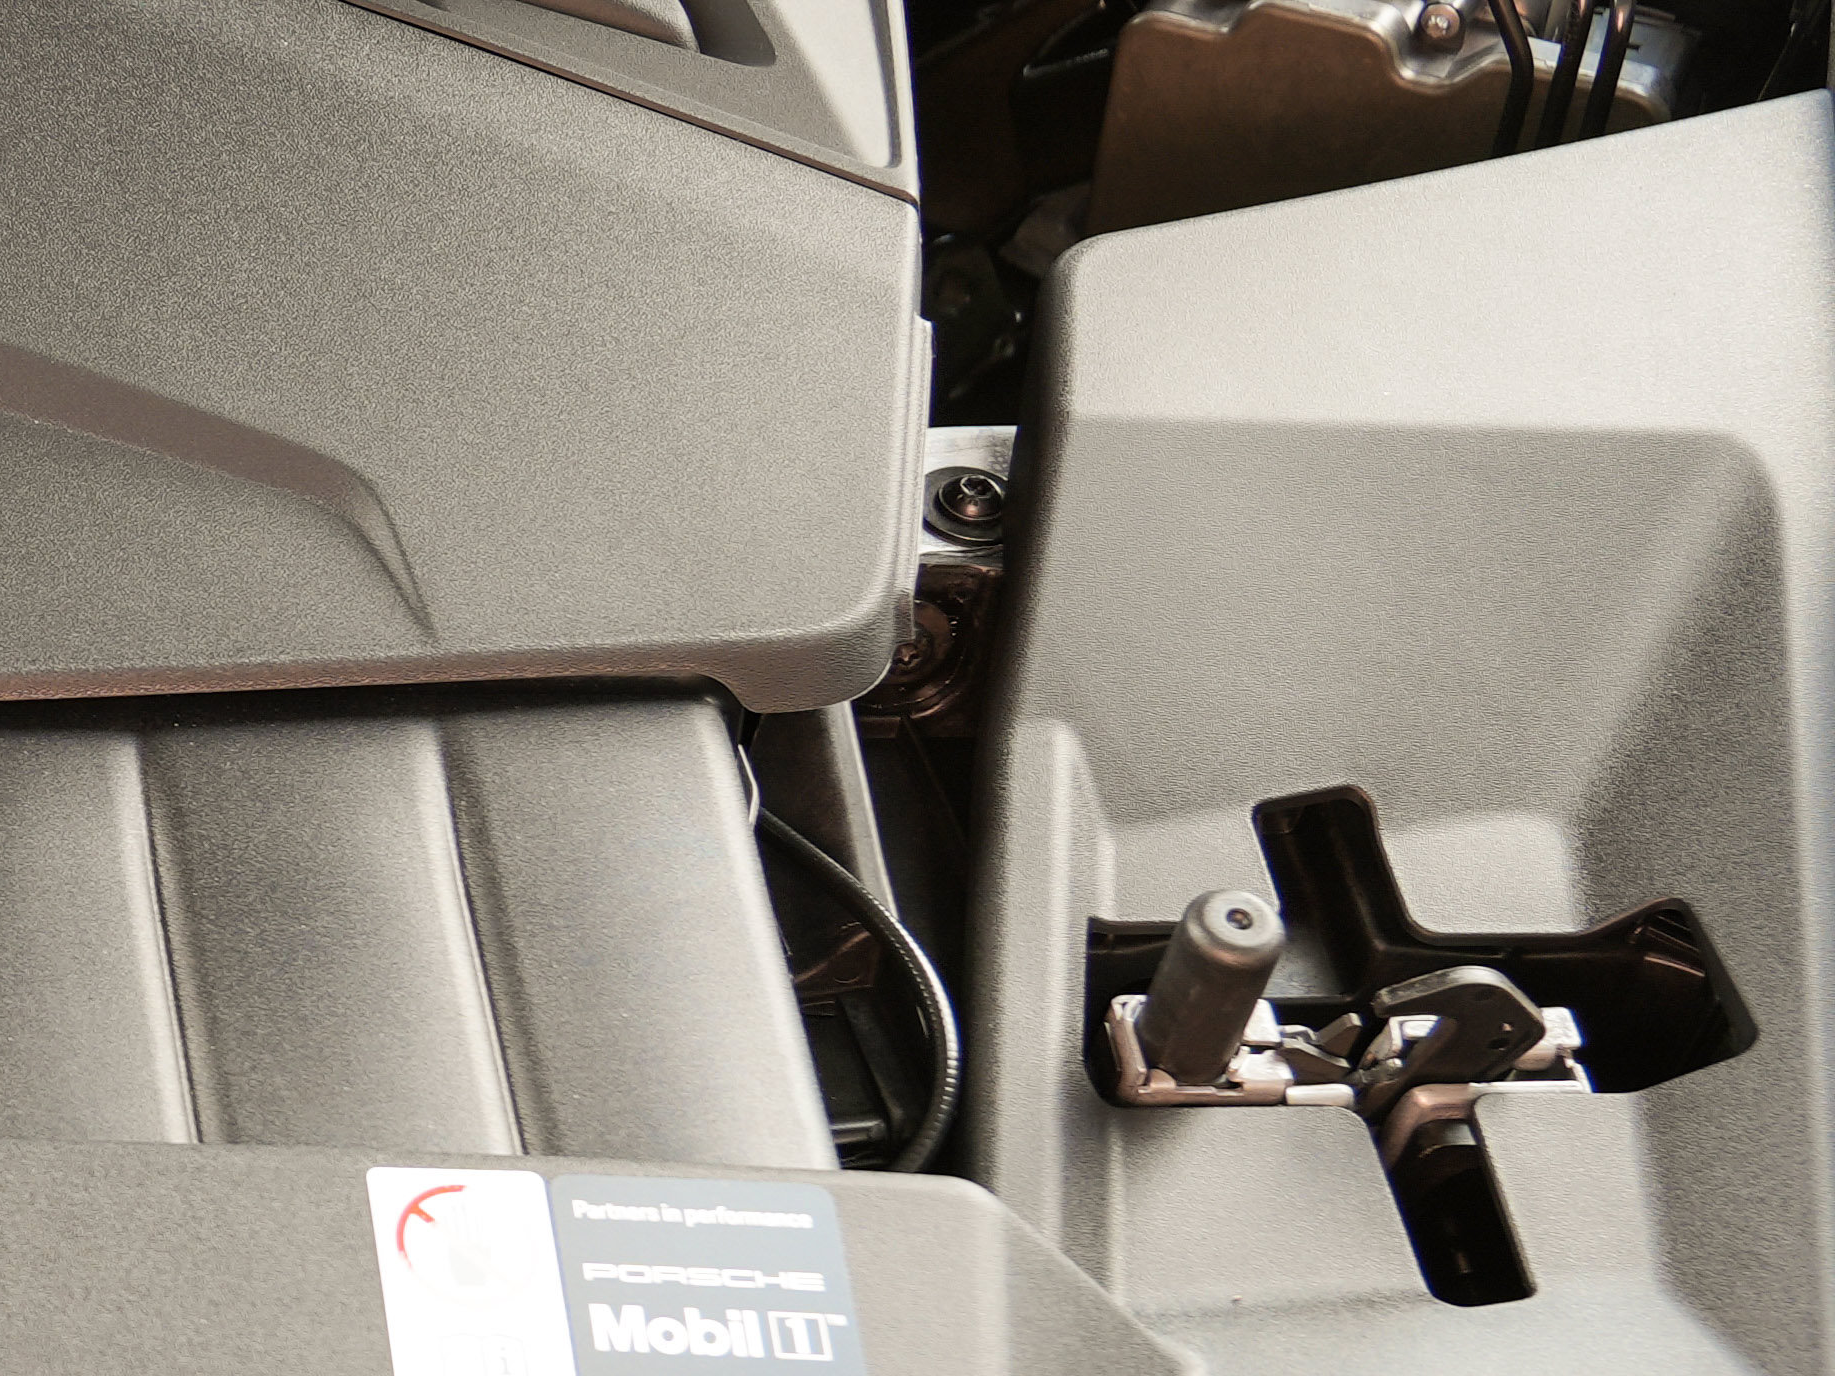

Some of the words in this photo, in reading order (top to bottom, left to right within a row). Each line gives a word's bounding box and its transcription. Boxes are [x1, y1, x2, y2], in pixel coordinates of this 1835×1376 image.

[572, 1199, 661, 1223] Partners
[660, 1202, 683, 1224] in
[683, 1205, 813, 1229] performance
[582, 1262, 826, 1291] PORSCHE
[588, 1302, 765, 1359] Mobil
